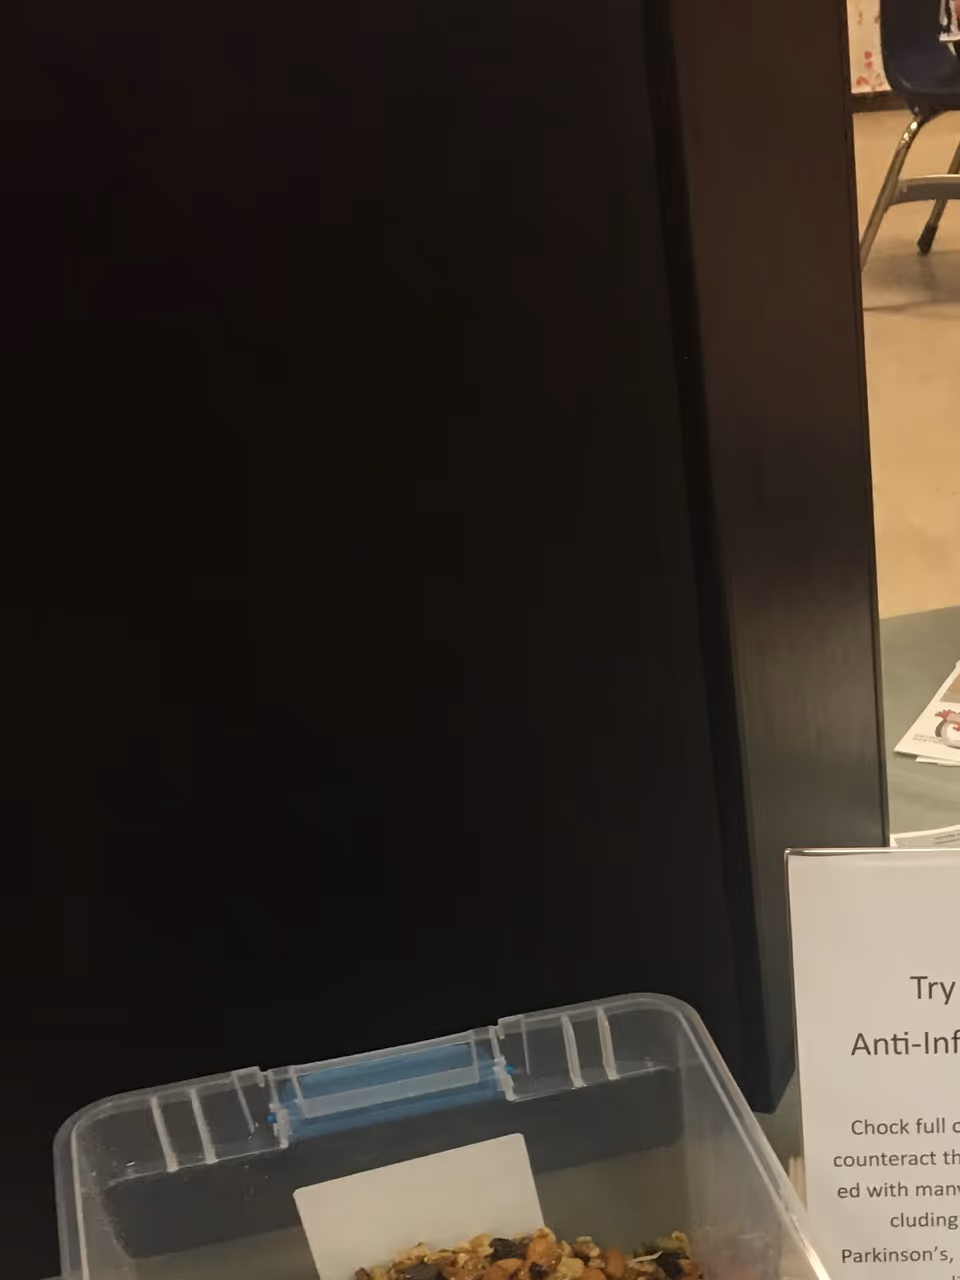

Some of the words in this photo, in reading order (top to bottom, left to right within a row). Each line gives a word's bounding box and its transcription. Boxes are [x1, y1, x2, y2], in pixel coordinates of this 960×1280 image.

[910, 976, 956, 1005] Try
[851, 1119, 910, 1135] Chock
[915, 1117, 945, 1134] full
[833, 1152, 936, 1167] counteract
[837, 1183, 860, 1199] ed
[867, 1182, 908, 1198] with
[890, 1212, 958, 1230] cluding
[842, 1246, 953, 1263] Parkinson’s,
